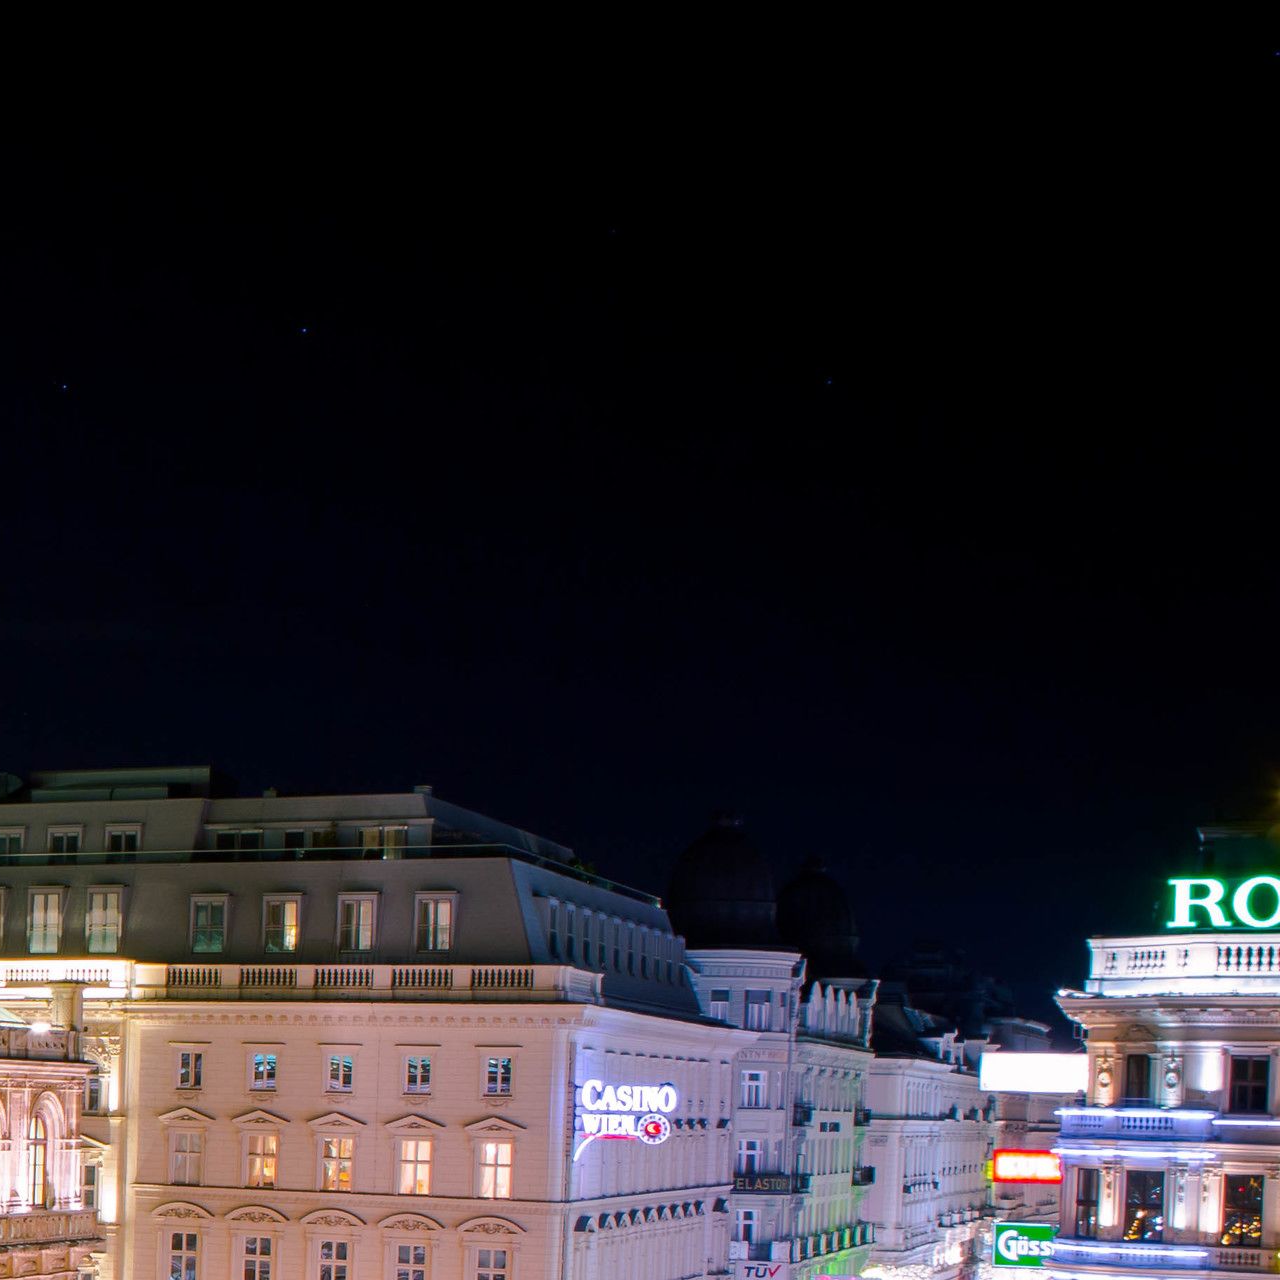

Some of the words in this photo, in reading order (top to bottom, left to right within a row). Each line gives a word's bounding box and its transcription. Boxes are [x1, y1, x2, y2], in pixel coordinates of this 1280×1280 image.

[582, 1079, 677, 1113] CASINO
[582, 1114, 637, 1136] WIEN
[998, 1229, 1054, 1262] Göss
[744, 1263, 782, 1279] TÜV
